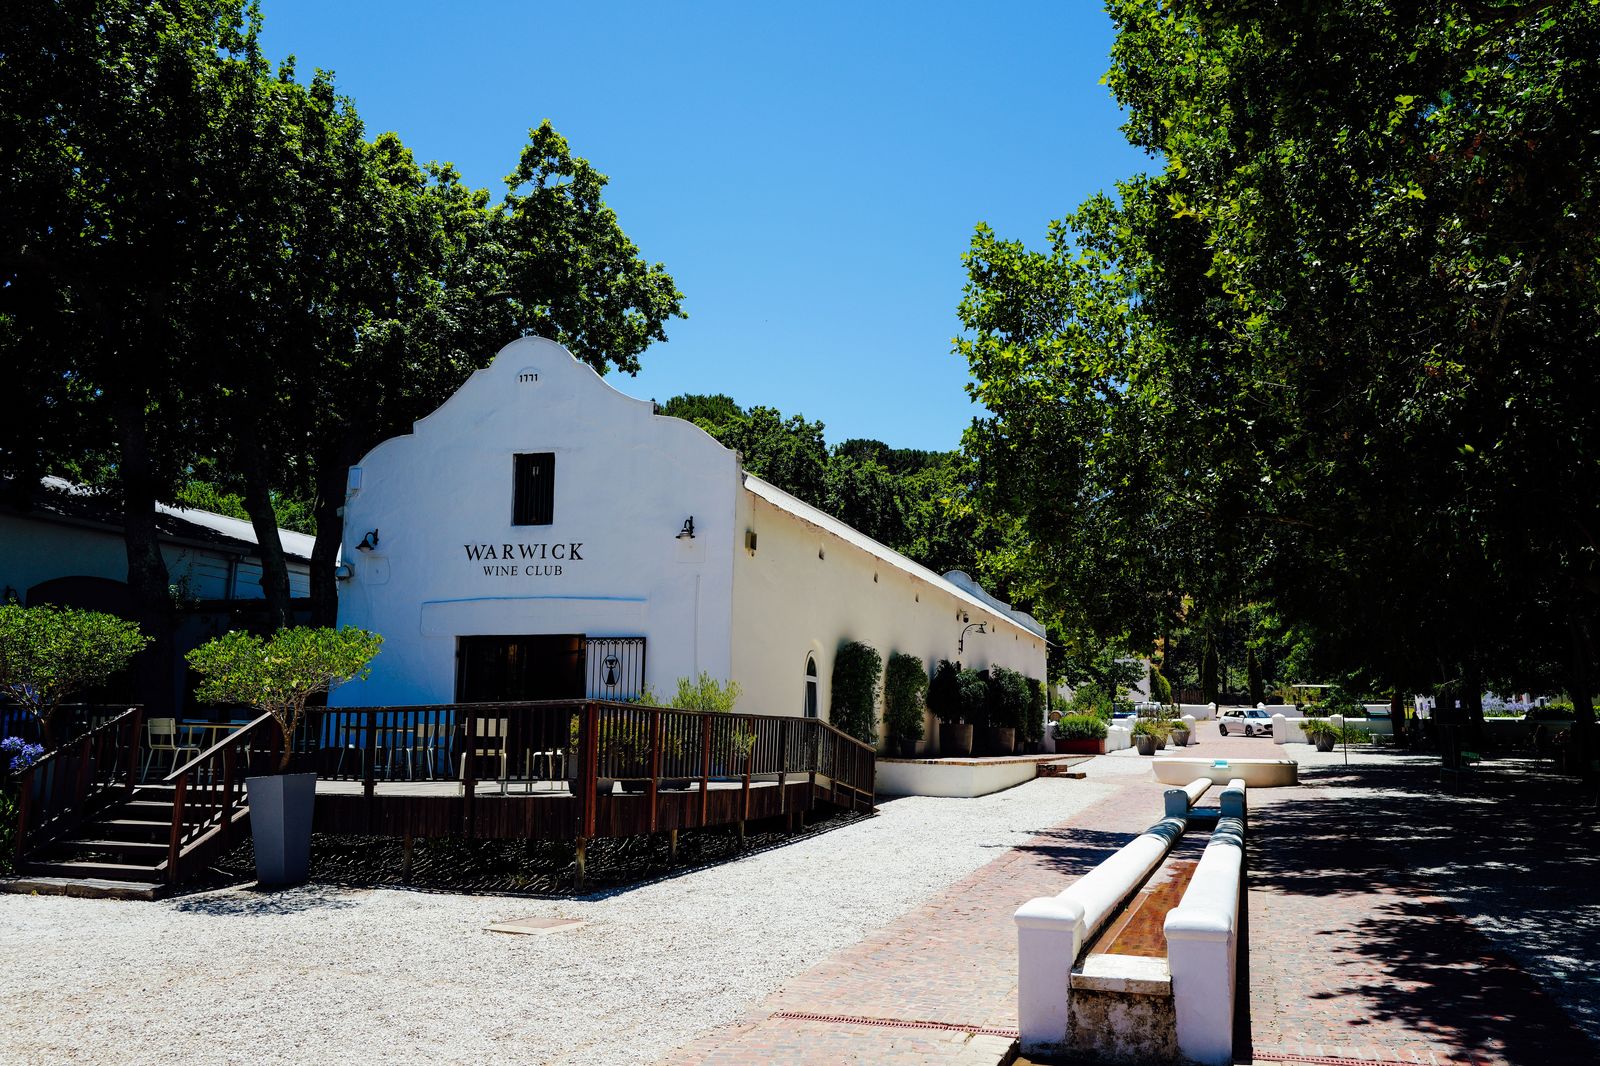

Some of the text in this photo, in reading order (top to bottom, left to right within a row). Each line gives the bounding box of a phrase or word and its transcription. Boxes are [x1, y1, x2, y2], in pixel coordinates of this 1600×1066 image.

[519, 373, 538, 383] 1771
[464, 543, 584, 561] WARWICK
[483, 565, 563, 576] WINE CLUB
